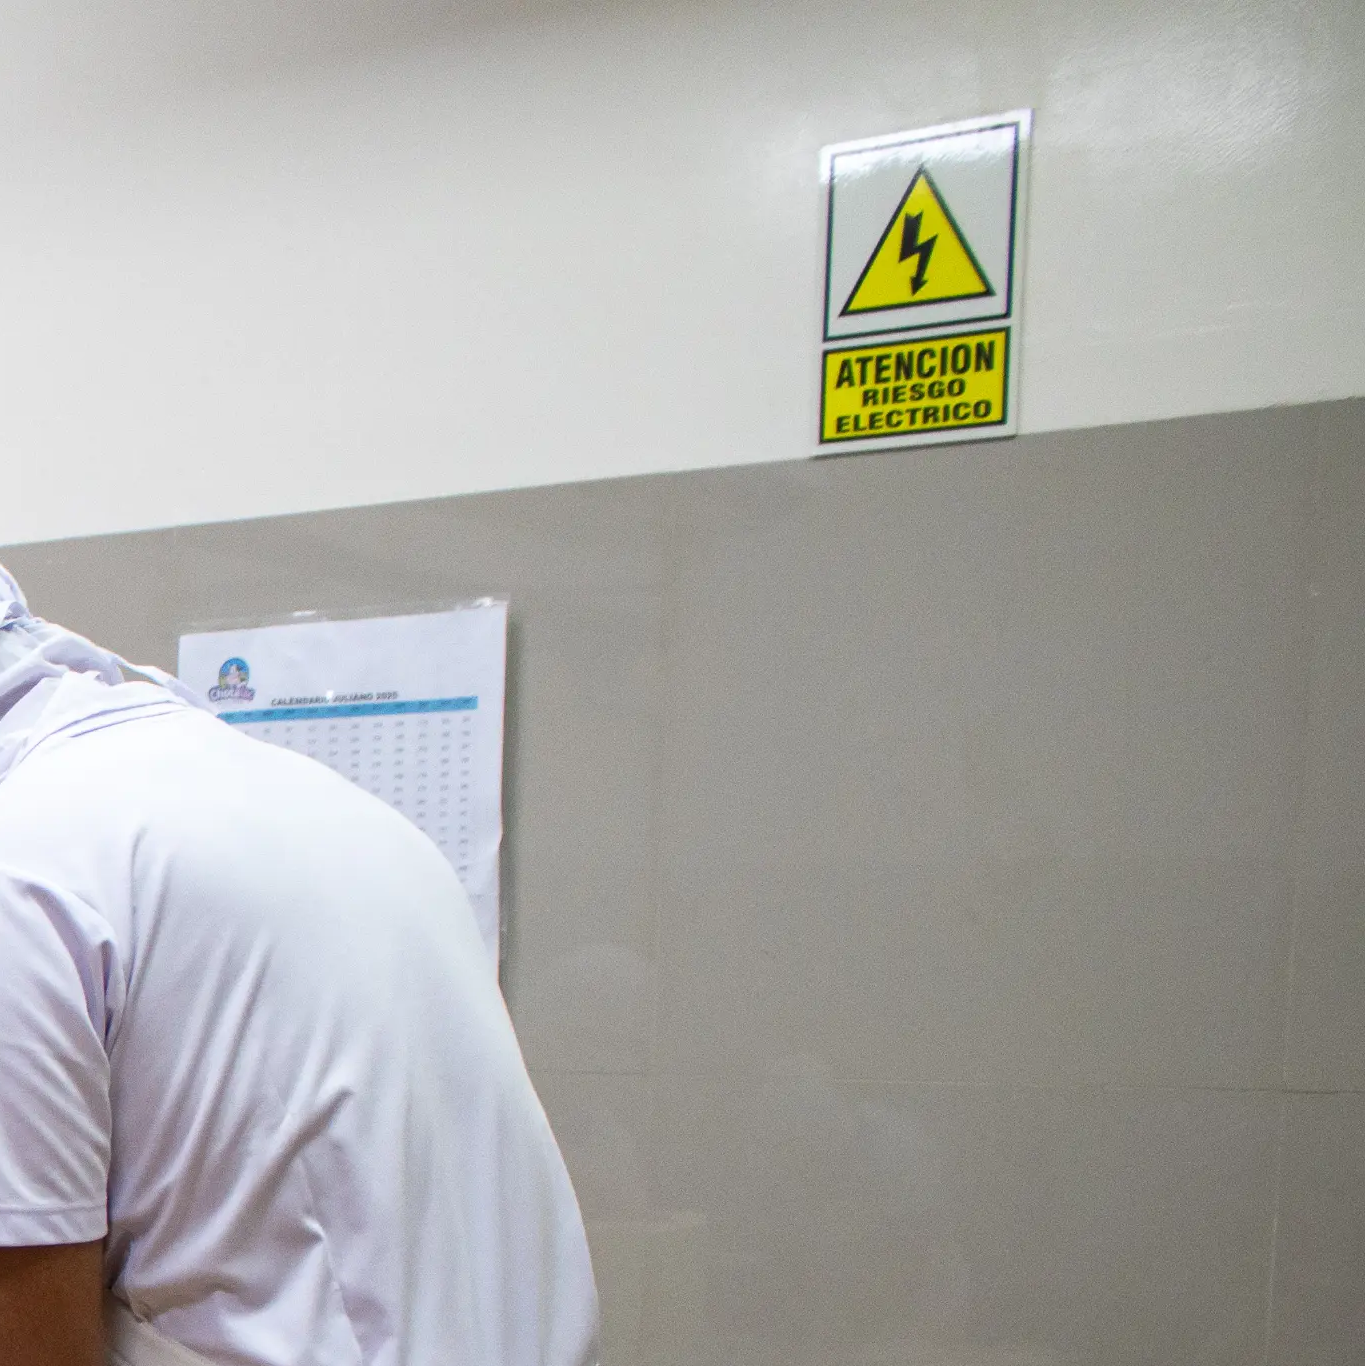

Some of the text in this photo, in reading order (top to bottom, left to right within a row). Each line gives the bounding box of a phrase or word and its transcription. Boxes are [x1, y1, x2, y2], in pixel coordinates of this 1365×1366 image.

[835, 340, 995, 389] ATENCION
[861, 377, 966, 408] RIESGO
[835, 399, 992, 434] ELECTRICO
